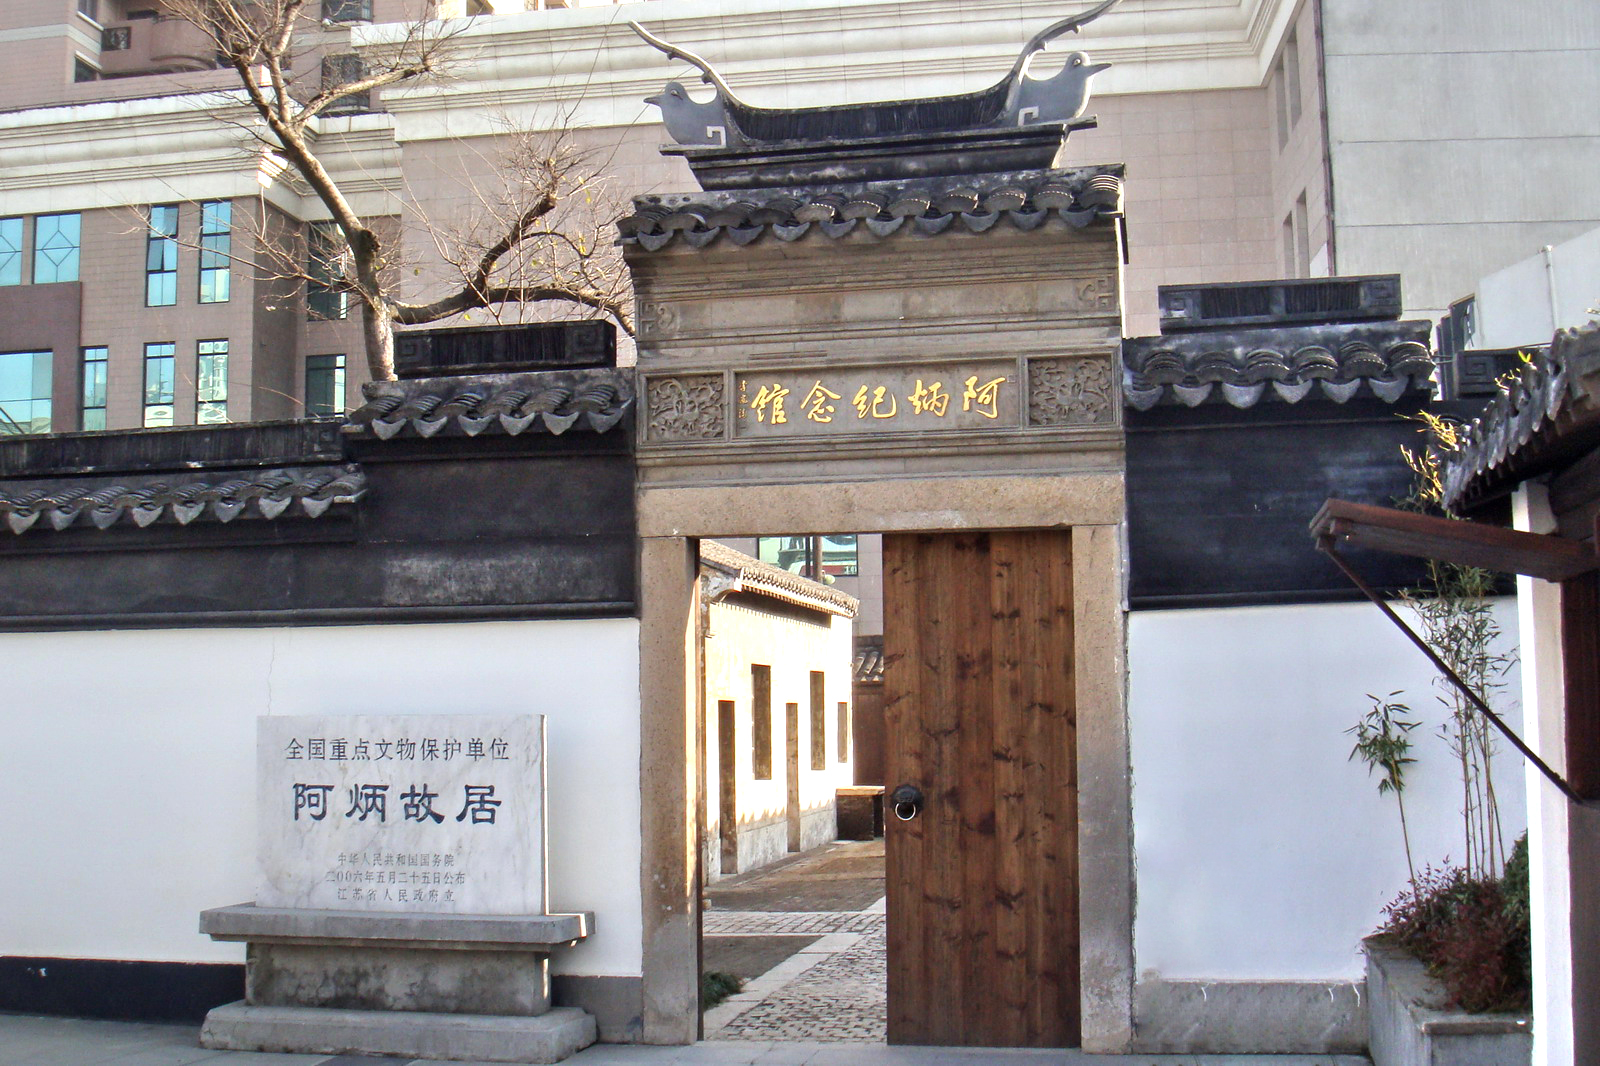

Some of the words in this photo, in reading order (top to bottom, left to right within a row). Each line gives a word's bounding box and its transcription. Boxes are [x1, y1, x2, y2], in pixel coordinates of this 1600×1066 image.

[285, 737, 510, 761] 全国重点文物保护单位
[292, 783, 502, 825] 阿炳故居
[337, 852, 455, 867] 中华人民共和国国务院
[337, 887, 455, 903] 江苏省人民政府立
